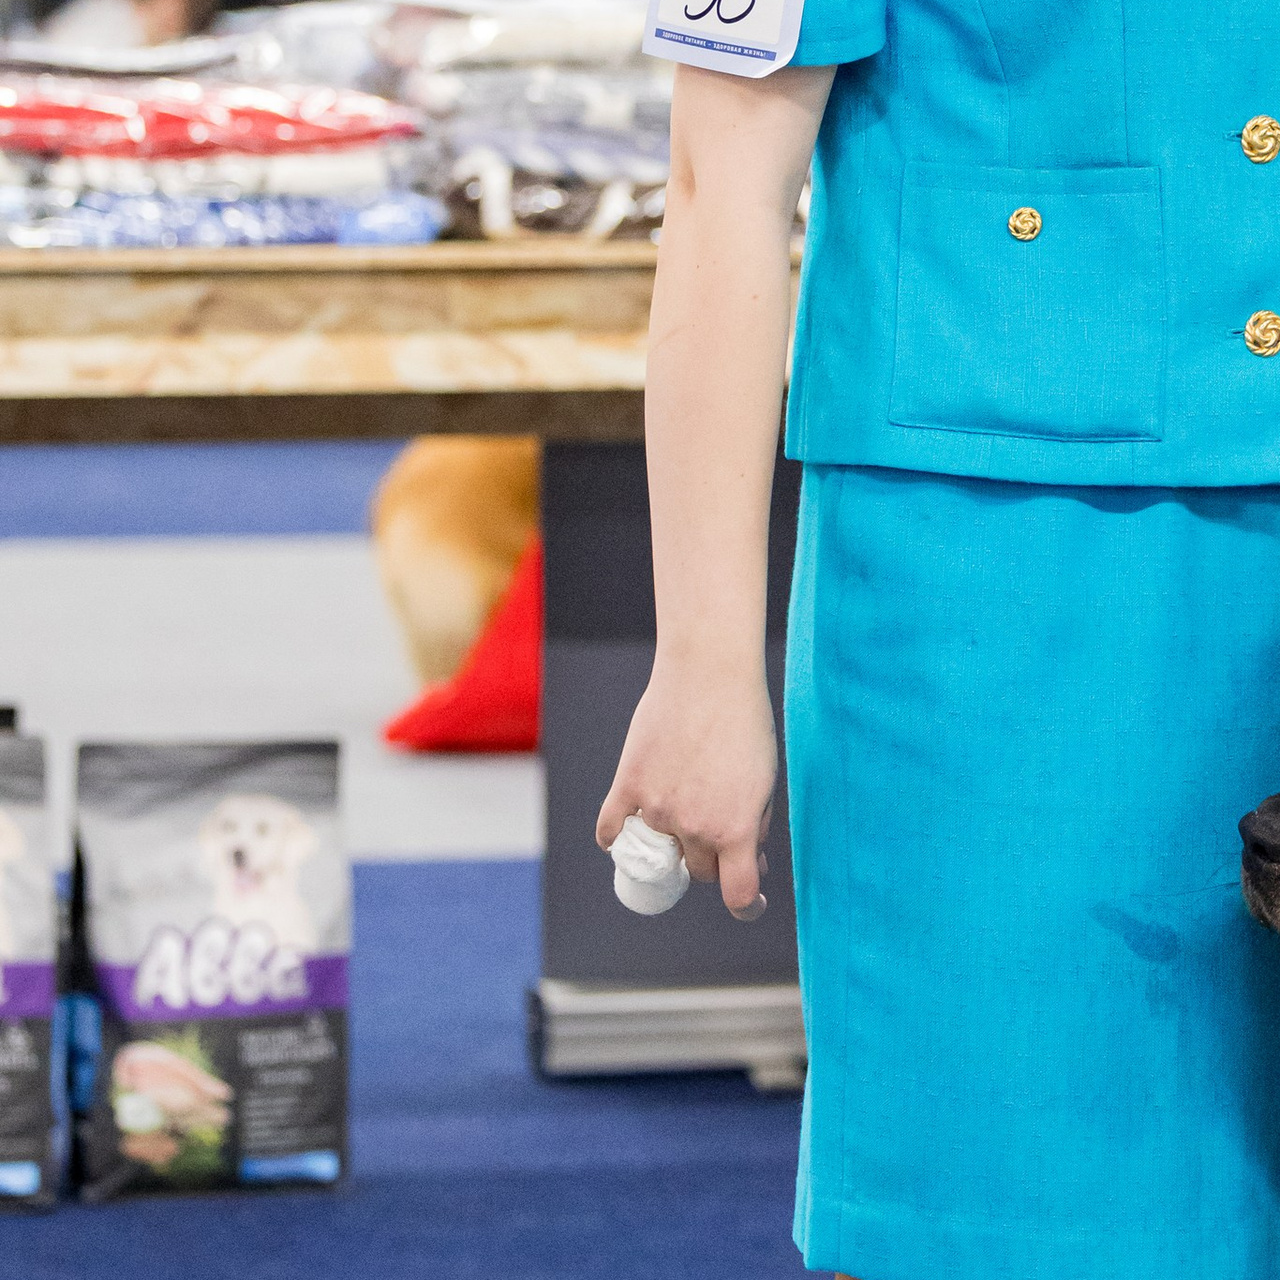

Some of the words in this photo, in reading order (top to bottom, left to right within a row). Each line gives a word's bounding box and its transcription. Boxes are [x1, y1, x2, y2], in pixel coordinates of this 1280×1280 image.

[684, 36, 707, 47] ПИТАНИЕ
[713, 42, 742, 54] ЗДОРОВАЯ
[743, 48, 767, 58] ЖИЗНЬ!
